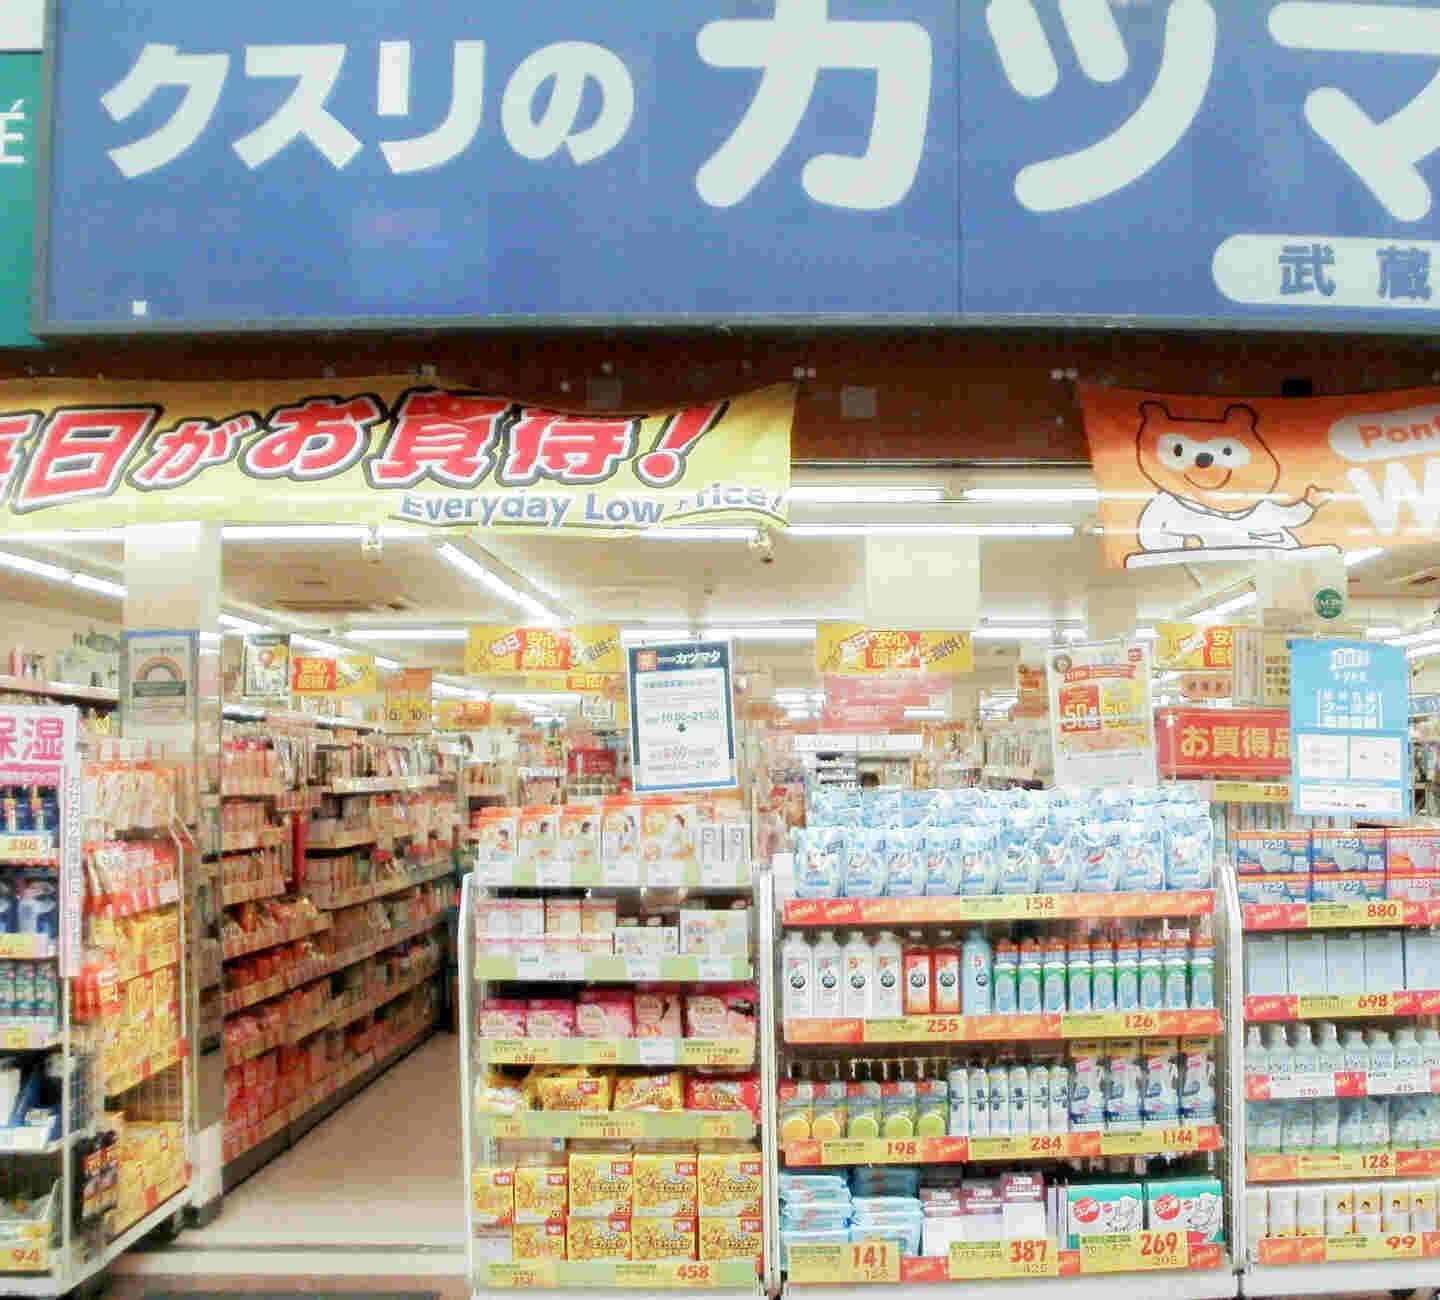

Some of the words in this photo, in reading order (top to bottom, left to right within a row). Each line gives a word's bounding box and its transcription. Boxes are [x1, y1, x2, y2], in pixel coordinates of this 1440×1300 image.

[100, 40, 635, 179] クスリの
[400, 492, 571, 527] Everyday
[584, 493, 665, 524] Low
[1025, 898, 1055, 912] 158
[1367, 903, 1397, 918] 880
[1358, 994, 1388, 1009] 698
[927, 1019, 959, 1033] 255
[887, 1141, 917, 1156] 198
[1031, 1136, 1063, 1152] 284
[1360, 1155, 1390, 1170] 128
[1140, 1231, 1178, 1256] 269
[1386, 1235, 1418, 1249] 99
[852, 1245, 888, 1268] 141
[1009, 1240, 1048, 1263] 387
[676, 1264, 710, 1279] 458
